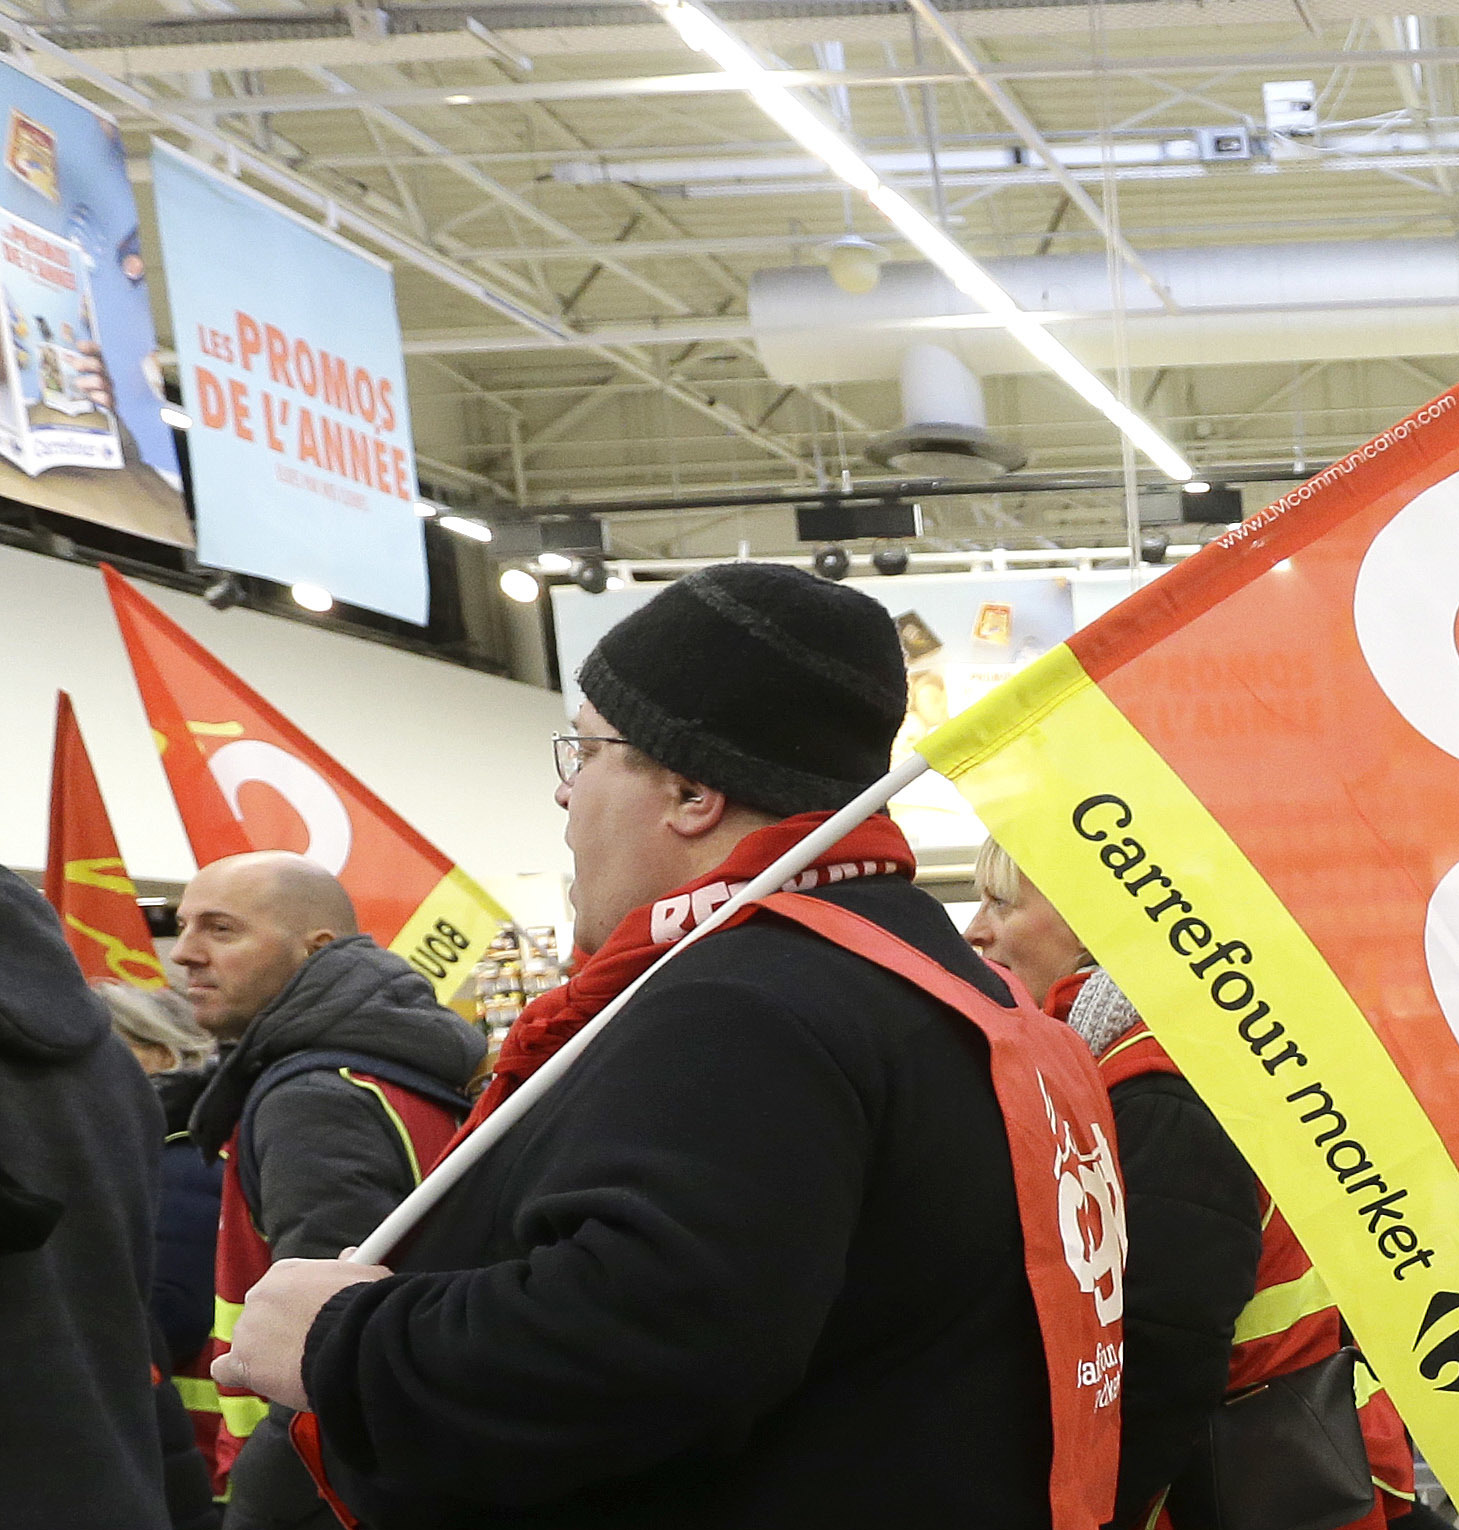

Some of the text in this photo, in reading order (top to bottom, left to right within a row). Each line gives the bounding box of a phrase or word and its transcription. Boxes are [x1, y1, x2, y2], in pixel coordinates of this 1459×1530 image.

[194, 364, 256, 443] DE
[198, 309, 397, 433] LES PROMOS
[1072, 793, 1435, 1281] Carrefour market
